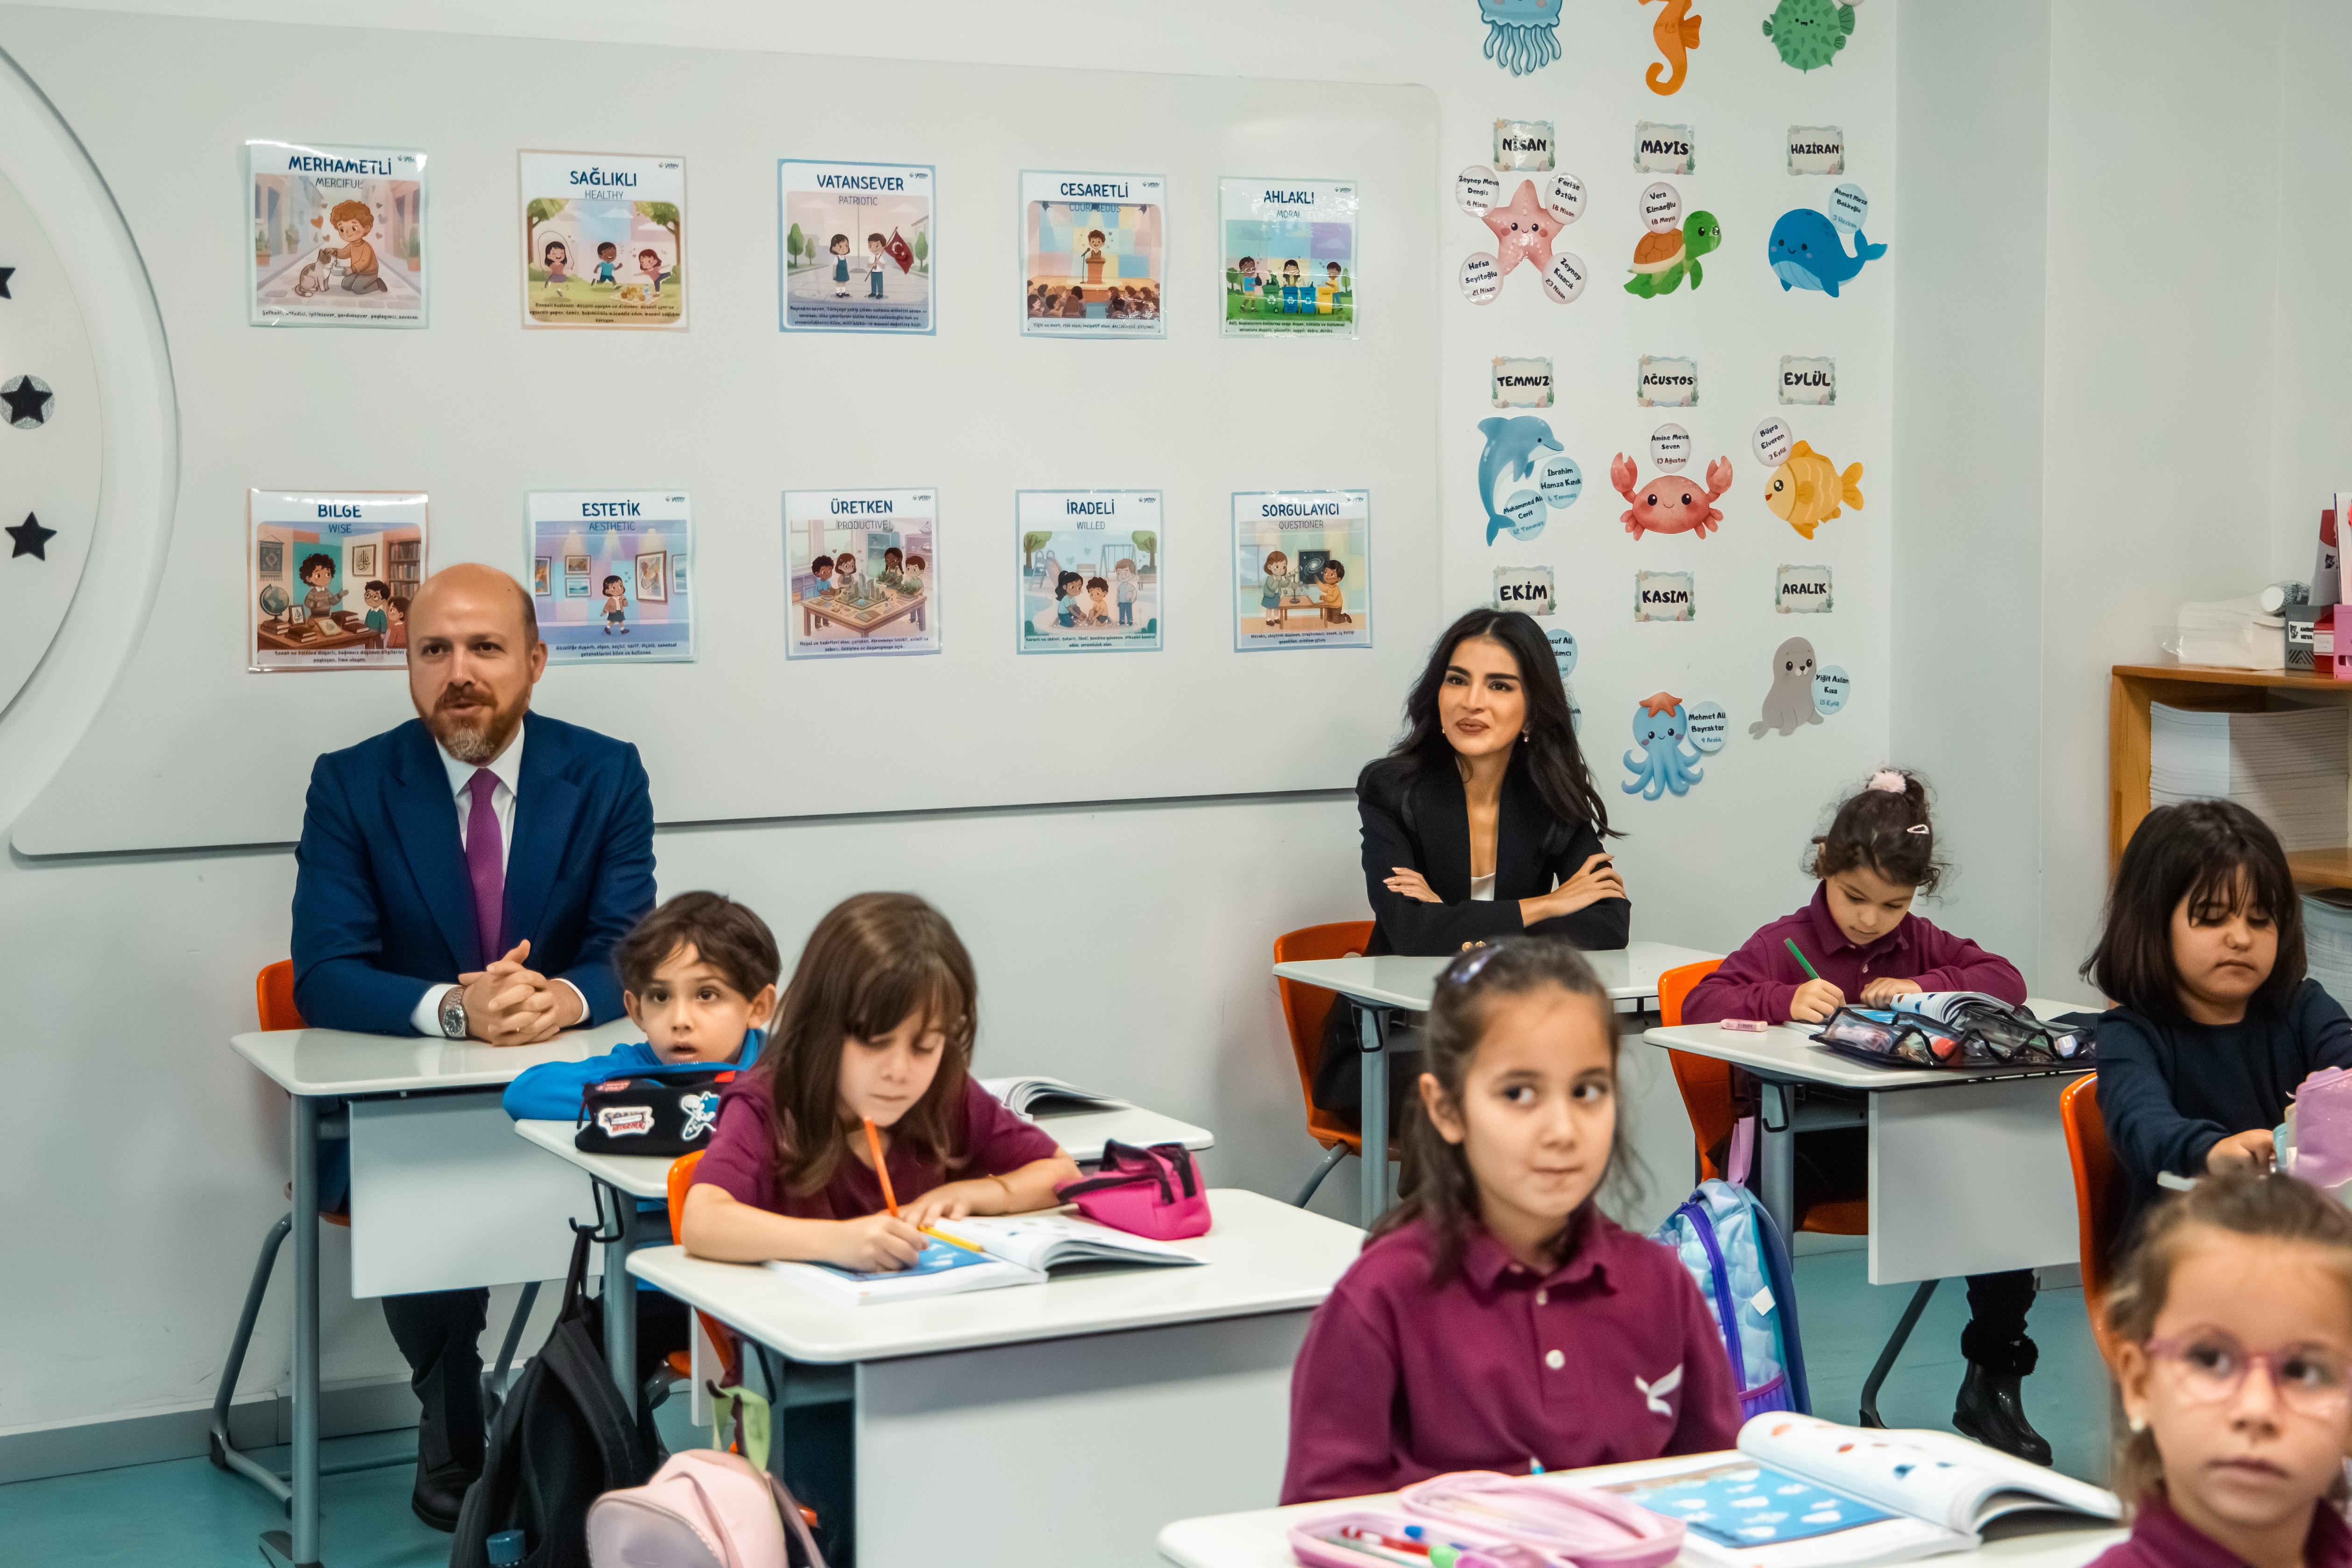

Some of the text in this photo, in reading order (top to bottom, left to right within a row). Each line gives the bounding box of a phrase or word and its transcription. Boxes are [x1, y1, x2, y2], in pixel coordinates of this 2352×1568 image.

[1503, 135, 1547, 152] NİSAN
[1641, 140, 1689, 155] MAYIS
[1791, 142, 1839, 155] HAZİRAN
[288, 156, 392, 175] MERHAMETLİ
[316, 177, 363, 189] MERCIFUL
[570, 167, 637, 187] SAĞLIKLI
[817, 175, 904, 191] VATANSEVER
[1458, 176, 1481, 185] Zeynep
[585, 190, 624, 199] HEALTHY
[1060, 182, 1129, 198] CESARETLİ
[1555, 187, 1577, 202] Öztürk
[1835, 188, 1867, 205] Ahmet Mirza
[839, 196, 878, 205] PATRIOTIC
[1264, 190, 1314, 204] AHLAKLI
[1069, 203, 1121, 212] COURAGEOUS
[1560, 207, 1575, 218] Nisan
[1646, 202, 1676, 213] Elmaoğlu
[1836, 199, 1861, 213] Bekiroğlu
[1469, 261, 1490, 270] Hafsa
[1561, 258, 1582, 281] Zeynep
[1465, 271, 1497, 283] Seyitoğlu
[1554, 268, 1574, 290] Kısacık
[1546, 278, 1566, 300] 23 Nisan
[1497, 375, 1550, 387] TEMMUZ
[1643, 373, 1694, 386] AĞUSTOS
[1784, 370, 1830, 387] EYLÜL
[1760, 424, 1778, 437] Büşra
[1761, 434, 1785, 449] Elveren
[1773, 446, 1787, 458] Eylül
[1547, 467, 1573, 476] İbrahim
[582, 500, 641, 517] ESTETİK
[831, 498, 893, 514] ÜRETKEN
[1067, 499, 1115, 515] İRADELİ
[1262, 503, 1339, 517] SORGULAYICI
[1504, 499, 1535, 514] Muhammed
[1518, 509, 1533, 519] Cerit
[329, 523, 352, 533] WISE
[589, 522, 636, 531] AESTHETIC
[838, 520, 887, 530] PRODUCTIVE
[1077, 521, 1105, 530] WILLED
[1279, 520, 1324, 530] QUESTIONER
[1520, 521, 1544, 532] Temmuz
[1500, 581, 1547, 601] EKİM
[1782, 583, 1827, 594] ARALIK
[1642, 590, 1688, 604] KASIM
[1832, 675, 1849, 684] Aslan
[1691, 725, 1724, 733] Bayraktar
